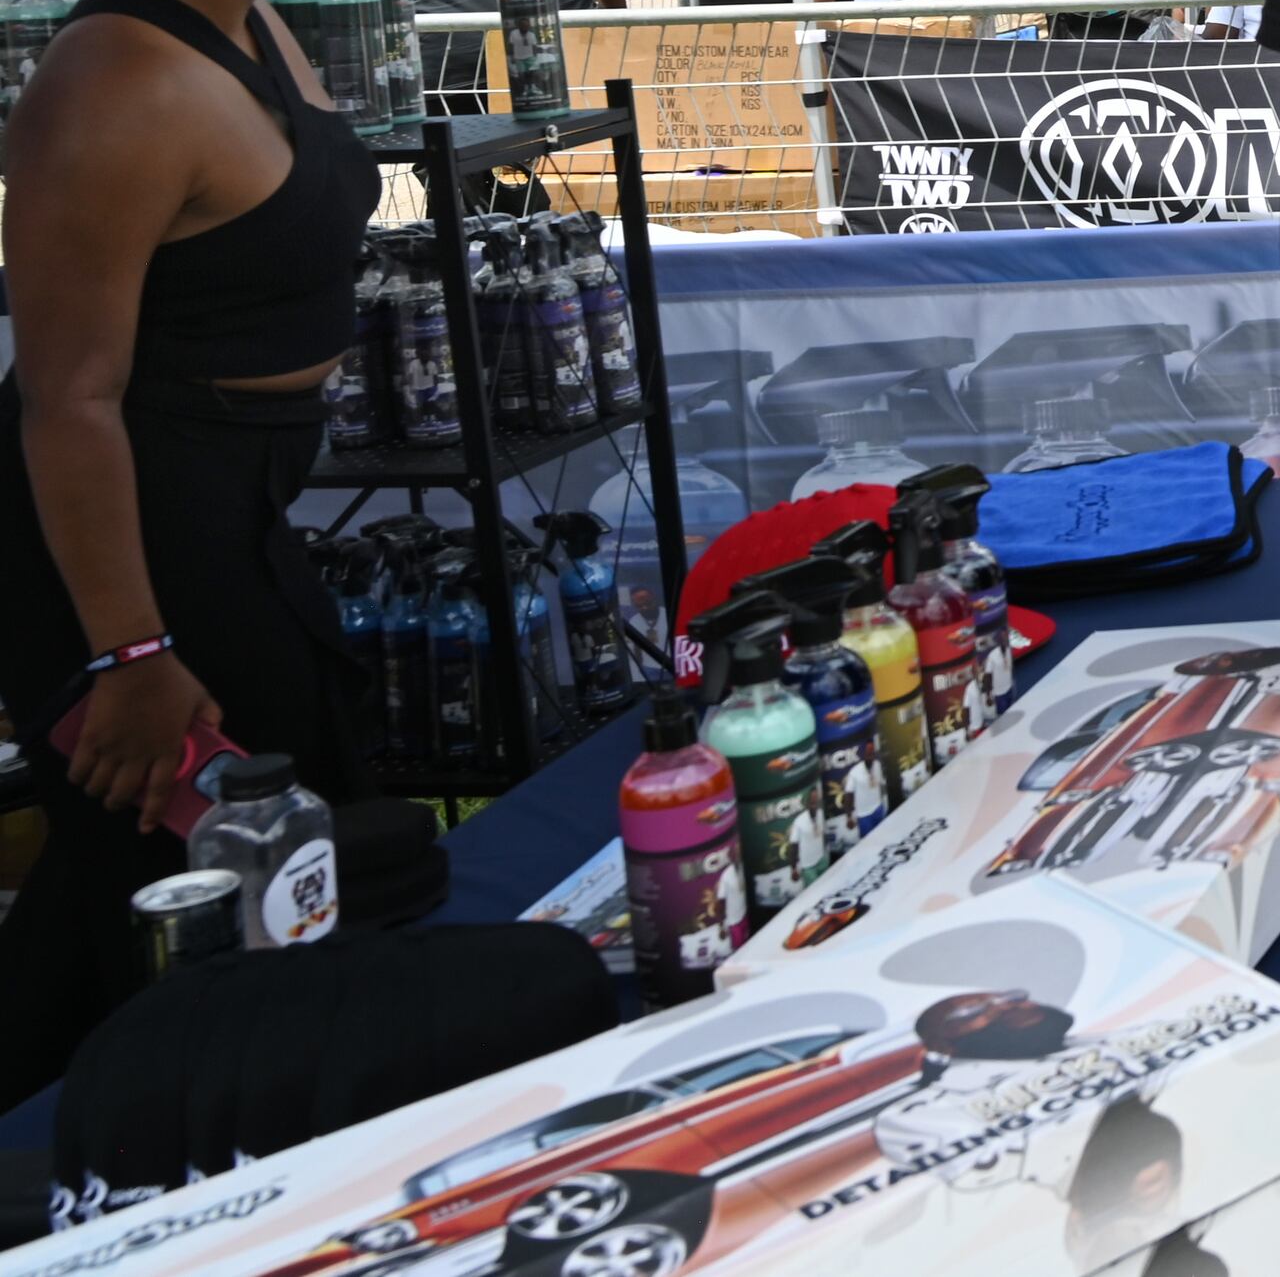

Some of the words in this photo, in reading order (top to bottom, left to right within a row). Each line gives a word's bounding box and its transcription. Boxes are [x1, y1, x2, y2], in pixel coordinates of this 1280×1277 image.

[731, 45, 789, 58] HEADWEAR
[656, 125, 699, 137] CARTON
[882, 179, 970, 209] TWO
[800, 1110, 1035, 1221] DETAILING
